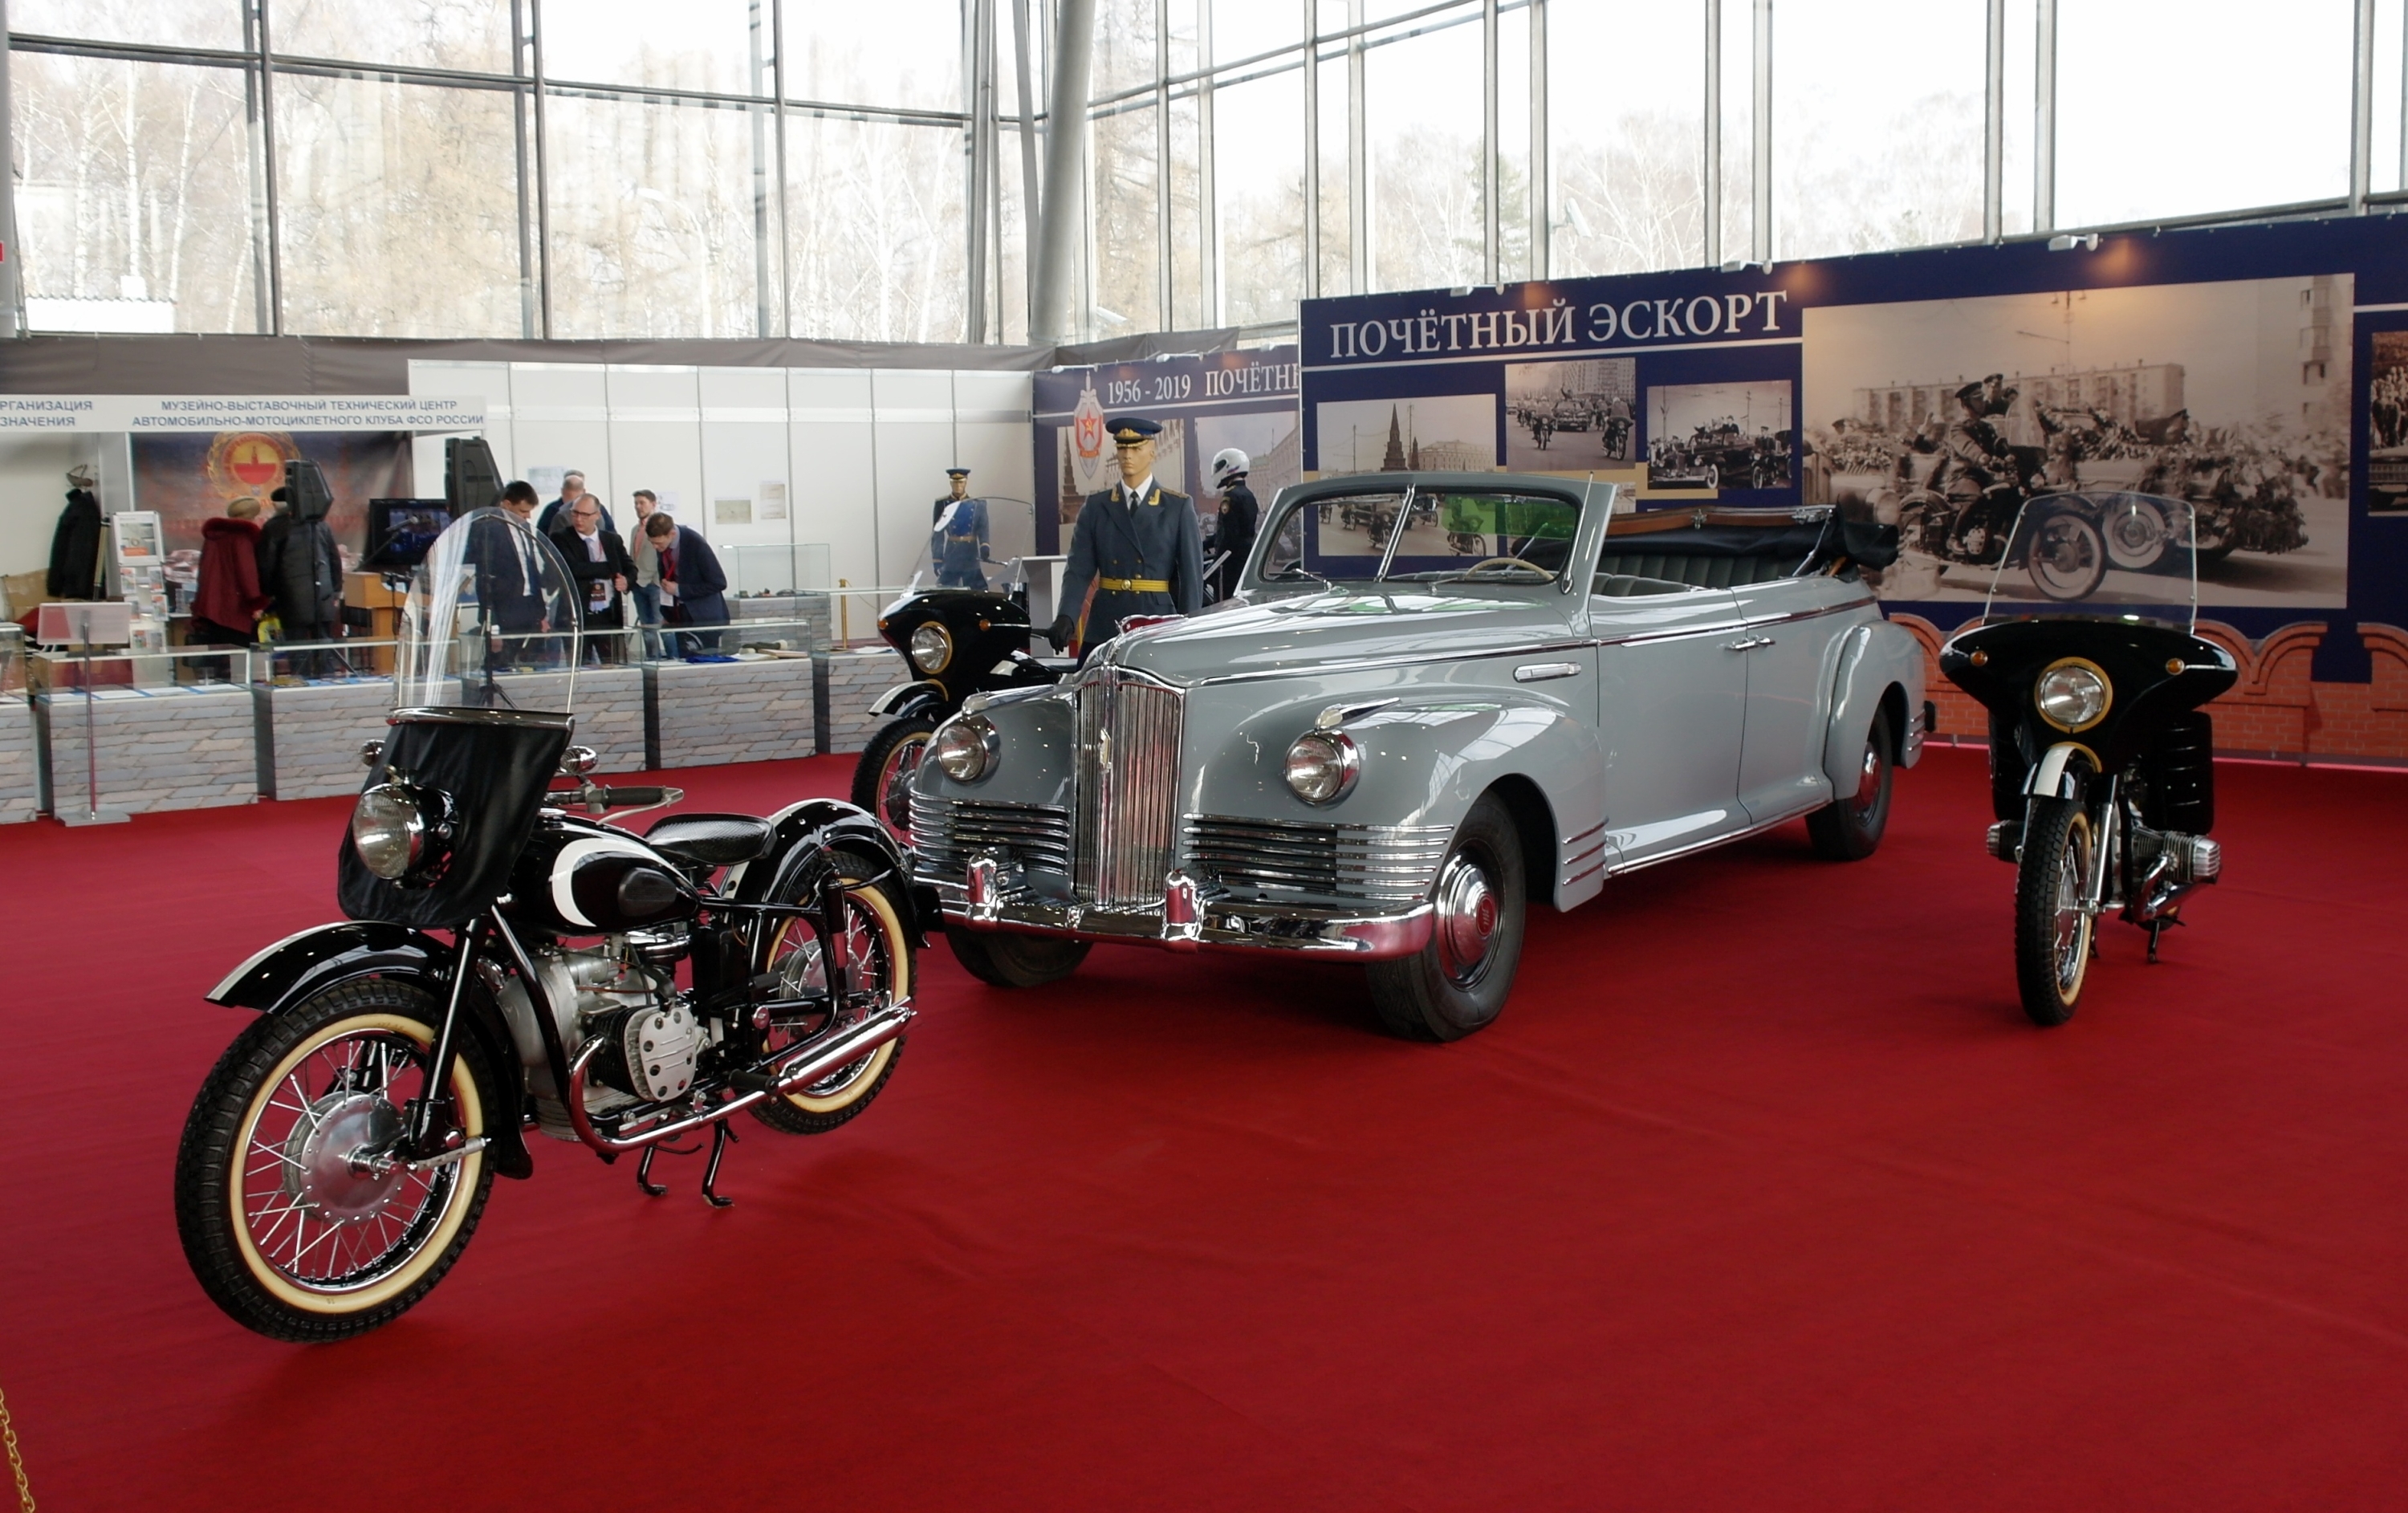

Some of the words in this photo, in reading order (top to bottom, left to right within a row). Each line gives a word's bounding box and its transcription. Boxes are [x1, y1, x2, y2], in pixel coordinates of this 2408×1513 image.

[1330, 299, 1576, 359] ПОЧЁТНЫЙ
[1587, 289, 1788, 342] ЭСКОРТ
[1108, 379, 1141, 405] 1956
[1154, 374, 1191, 401] 2019
[161, 400, 327, 411] МУЗЕЙНО-ВЫСТАВОЧНЫЙ
[332, 401, 416, 410] ТЕХНИЧЕСКИЙ
[420, 401, 457, 411] ЦЕНТР
[0, 417, 75, 426] ЗНАЧЕНИЯ
[132, 416, 361, 426] АВТОМОБИЛЬНО-МОТОЦИКЛЕТНОГО
[366, 416, 404, 425] КЛУБА
[407, 415, 433, 425] ФСО
[437, 415, 484, 425] РОССИИ
